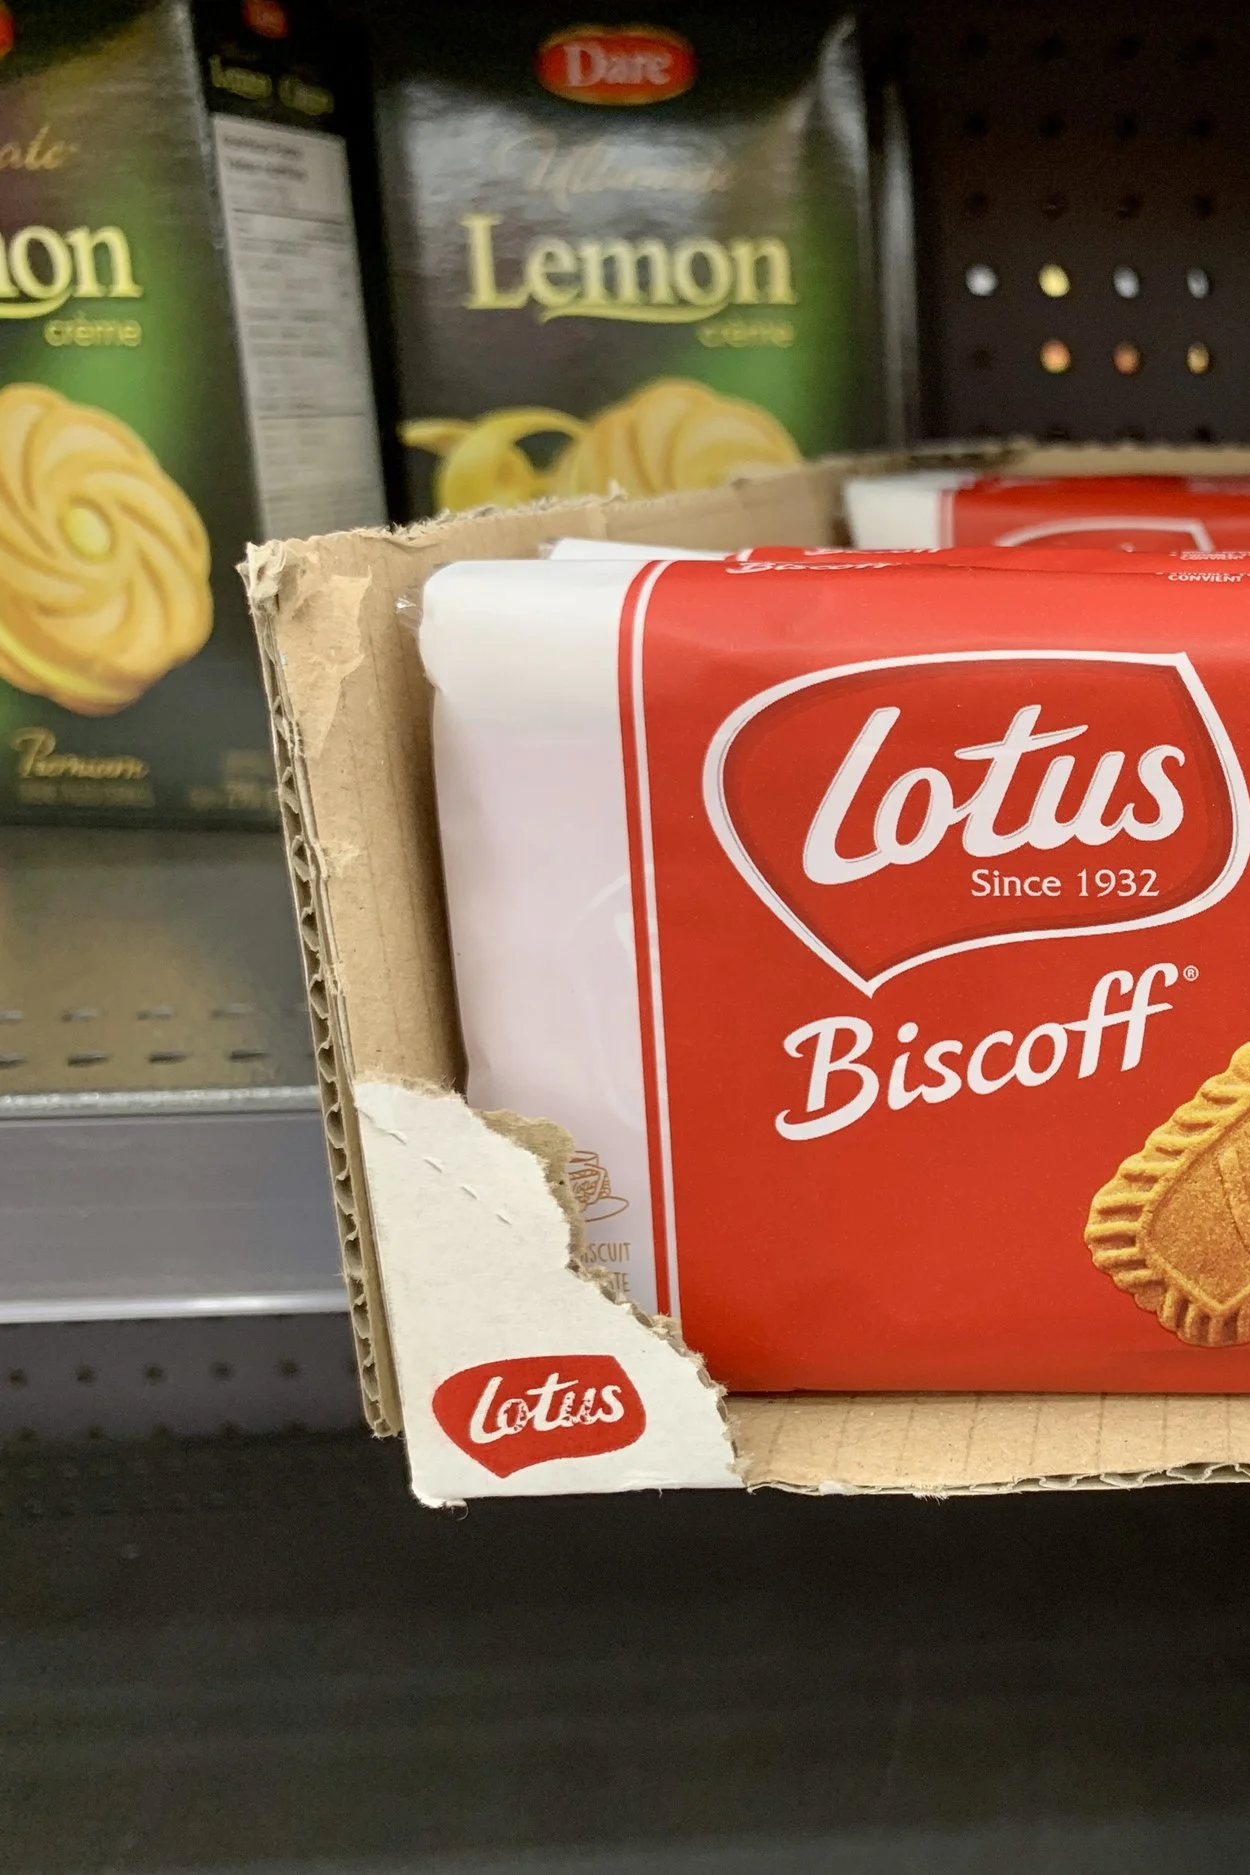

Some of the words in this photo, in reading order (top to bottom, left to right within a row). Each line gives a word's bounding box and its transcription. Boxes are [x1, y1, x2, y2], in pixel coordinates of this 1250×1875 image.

[563, 42, 672, 87] Dare
[0, 225, 143, 319] on
[461, 213, 797, 323] Lemon
[1168, 573, 1242, 583] CONVIENT
[803, 705, 1185, 885] Lotus
[971, 869, 1062, 898] Since
[1077, 868, 1161, 898] 1932
[469, 1372, 625, 1445] Lotus
